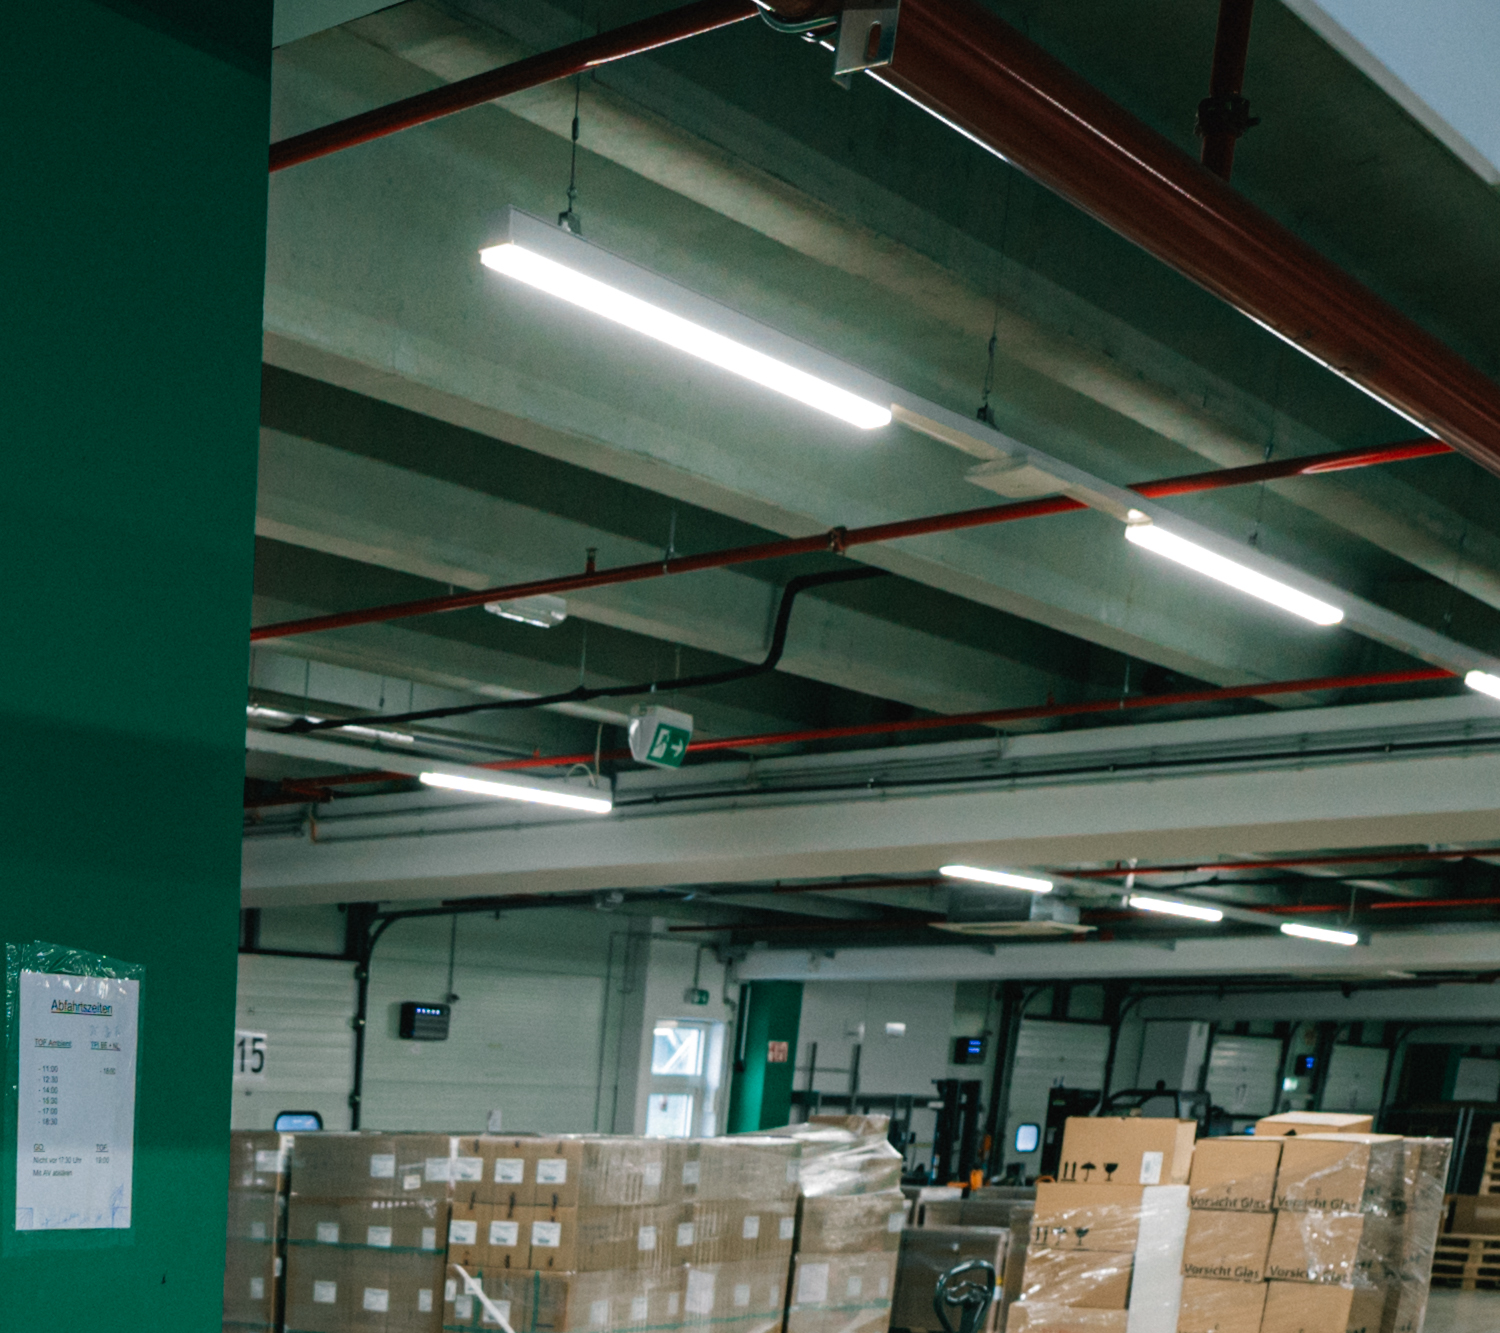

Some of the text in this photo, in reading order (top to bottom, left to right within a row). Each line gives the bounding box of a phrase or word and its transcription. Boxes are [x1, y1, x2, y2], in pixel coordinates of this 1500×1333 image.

[51, 999, 112, 1015] Abfahrtszeiten
[237, 1036, 264, 1073] 15
[1184, 1263, 1231, 1276] Vorsicht
